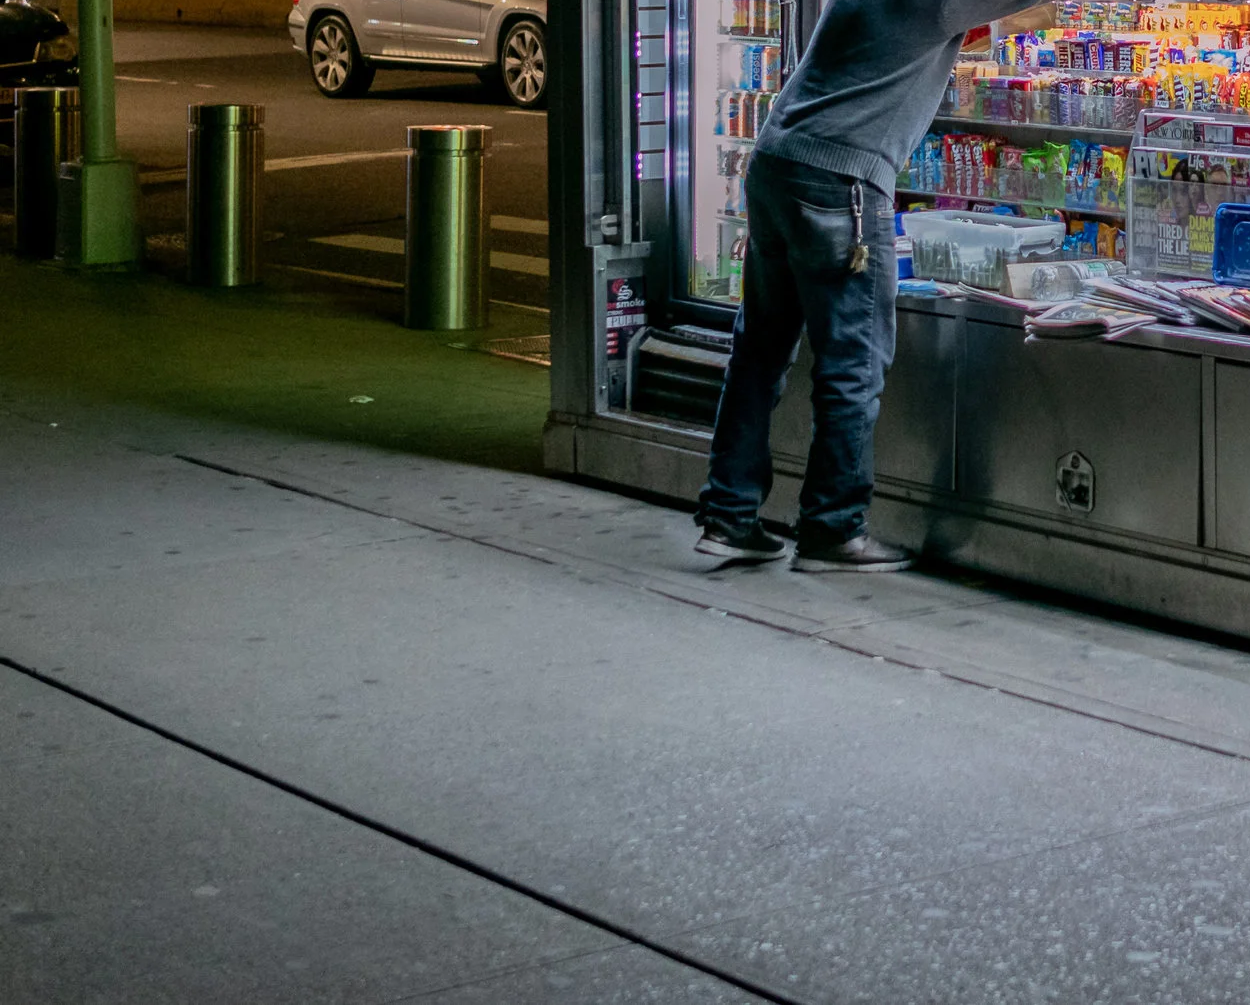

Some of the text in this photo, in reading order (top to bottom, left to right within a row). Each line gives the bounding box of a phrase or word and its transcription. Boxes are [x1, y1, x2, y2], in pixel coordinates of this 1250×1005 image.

[753, 52, 761, 81] pepsi
[1188, 154, 1204, 170] Life
[1159, 224, 1182, 239] TIRED
[1159, 239, 1174, 253] THE
